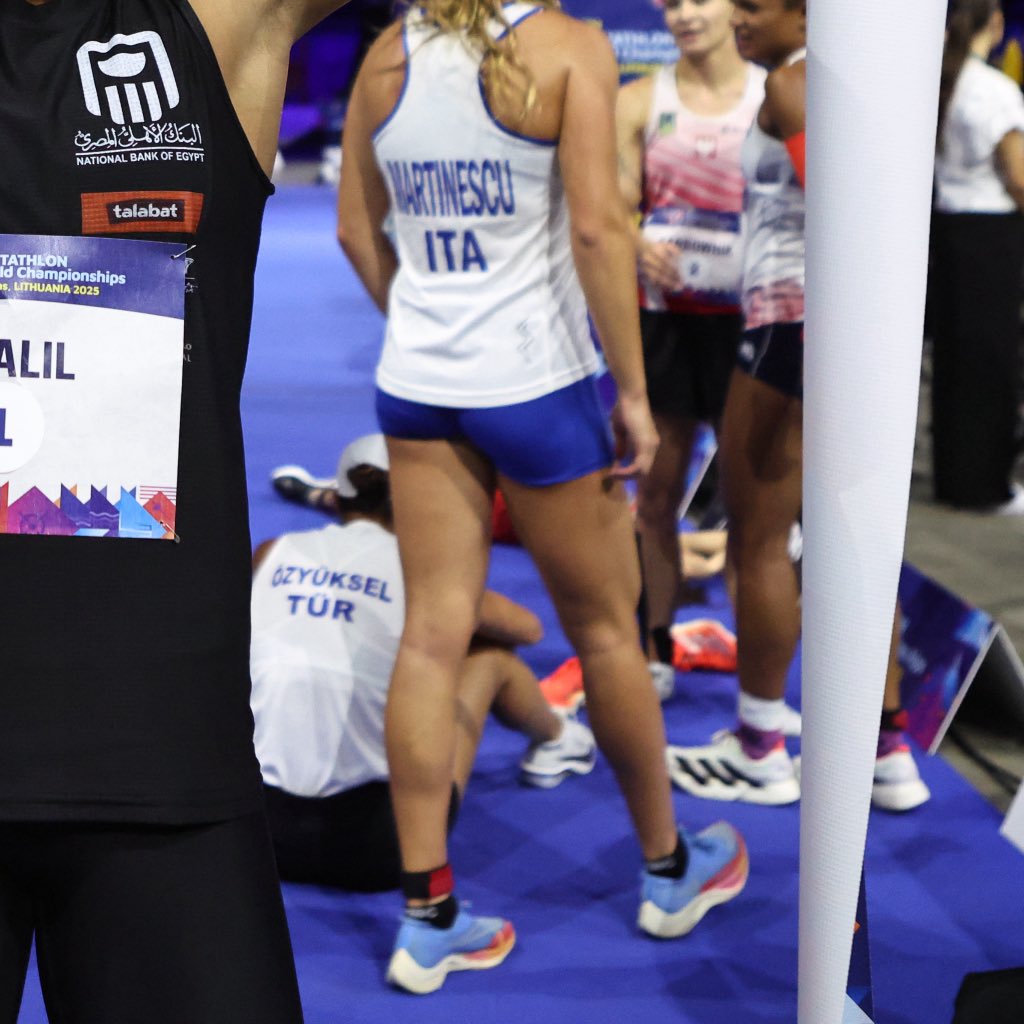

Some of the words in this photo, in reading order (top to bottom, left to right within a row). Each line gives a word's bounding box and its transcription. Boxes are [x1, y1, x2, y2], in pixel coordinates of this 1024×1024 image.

[76, 154, 128, 166] NATIONAL
[130, 152, 158, 162] BANK
[160, 151, 174, 161] OF
[176, 151, 205, 162] EGYPT
[387, 159, 516, 217] MARTINESCU
[112, 203, 178, 218] talabat
[425, 229, 488, 273] ITA
[17, 266, 126, 286] Championships
[14, 282, 71, 294] LITHUANIA
[73, 285, 100, 296] 2025
[287, 593, 355, 623] TÜR
